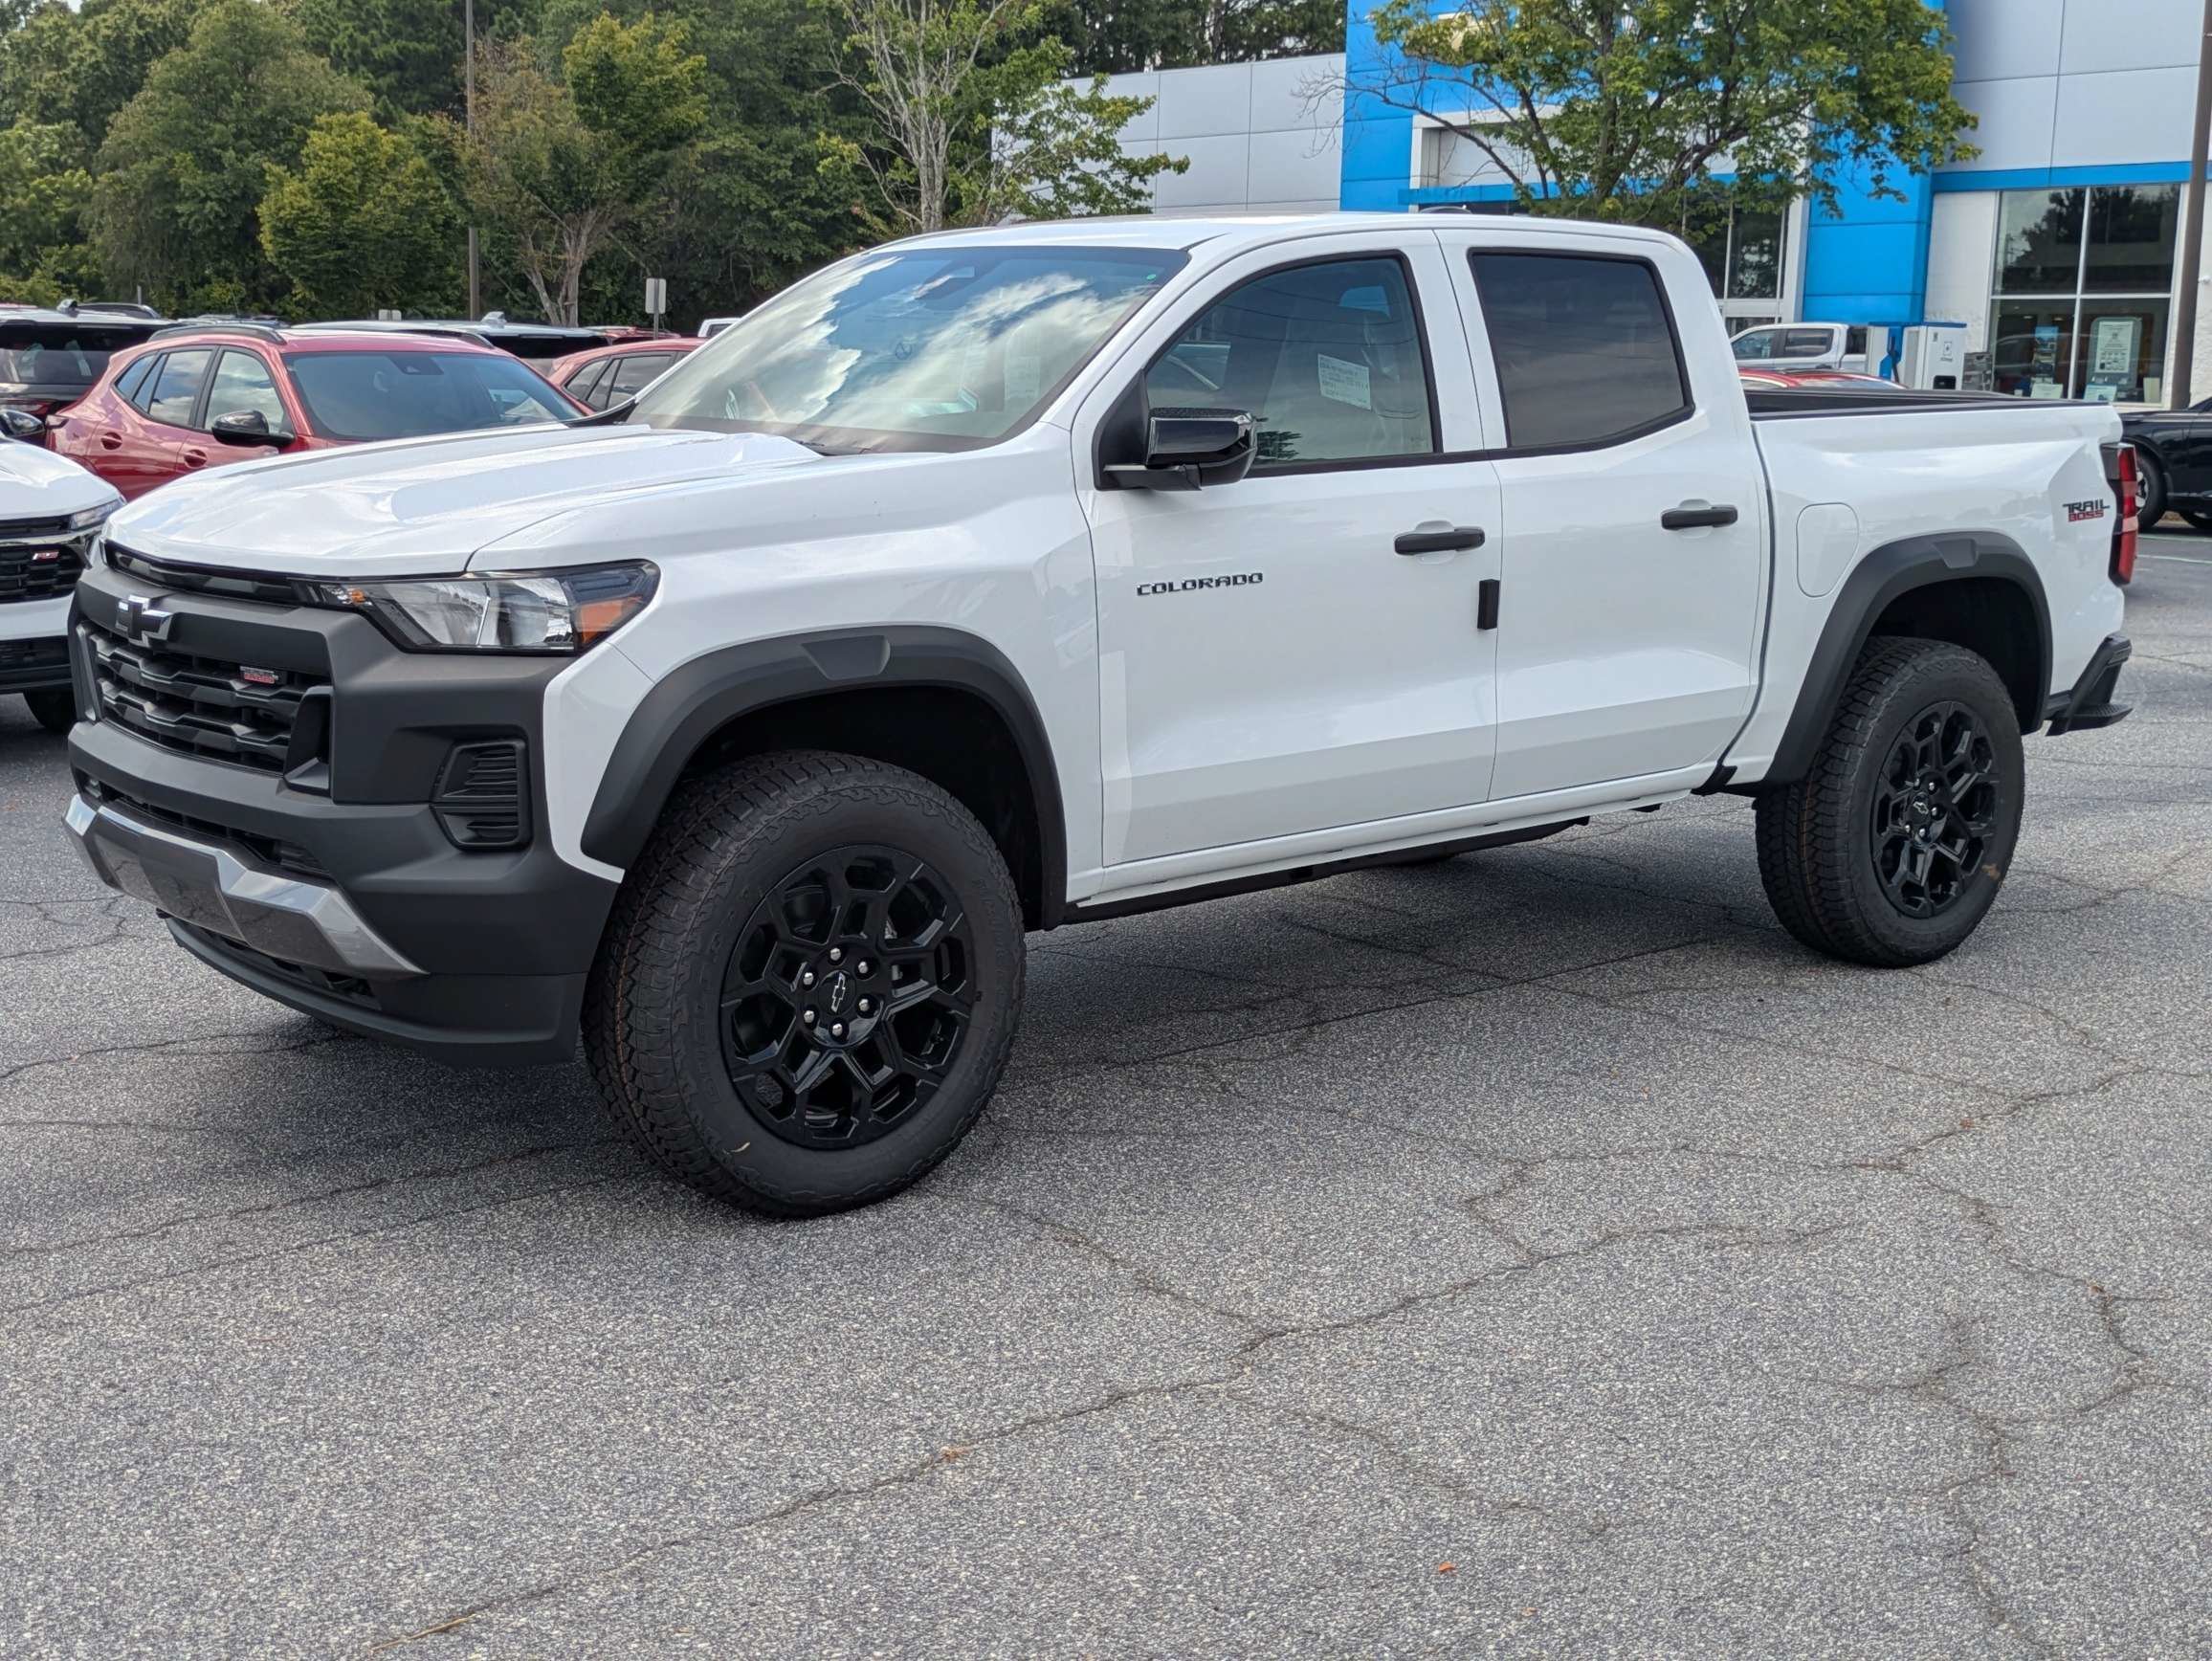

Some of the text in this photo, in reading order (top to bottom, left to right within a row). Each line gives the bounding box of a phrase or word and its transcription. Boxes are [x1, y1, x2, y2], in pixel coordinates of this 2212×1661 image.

[2062, 498, 2111, 513] TRAIL
[2068, 509, 2104, 522] BOSS
[1137, 572, 1263, 596] COLORADO
